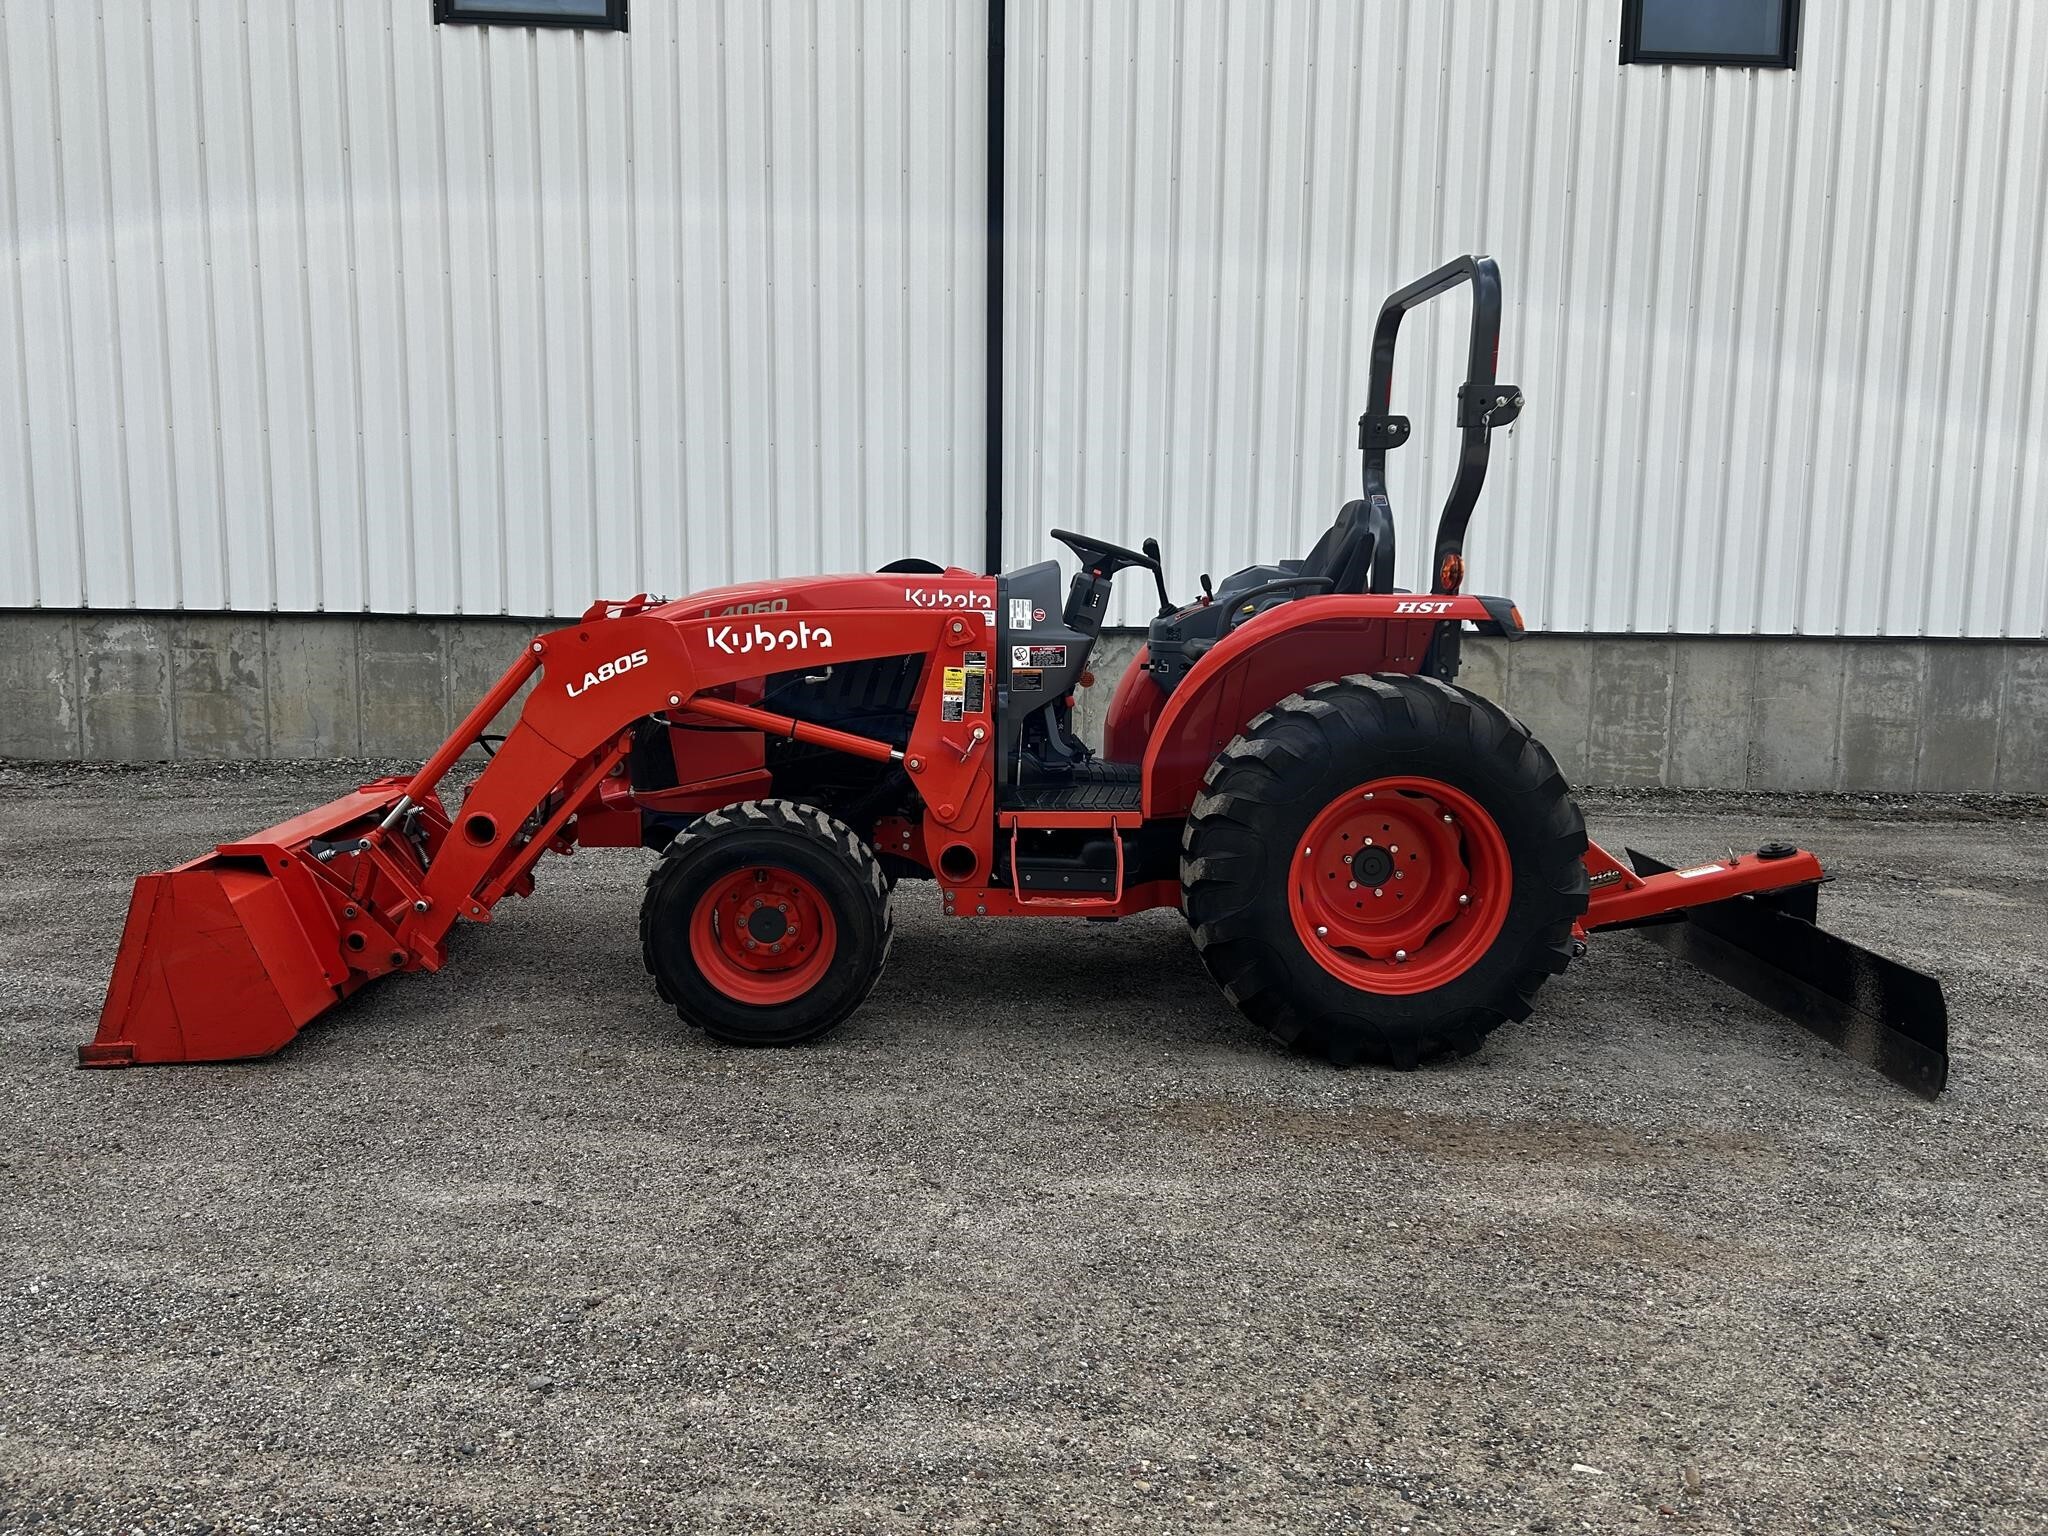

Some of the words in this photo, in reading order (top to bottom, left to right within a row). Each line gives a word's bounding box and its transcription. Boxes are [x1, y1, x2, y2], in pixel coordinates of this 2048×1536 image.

[905, 588, 992, 609] Kubota
[1393, 601, 1454, 614] HST
[706, 620, 833, 655] Kubota
[565, 648, 649, 698] LA805
